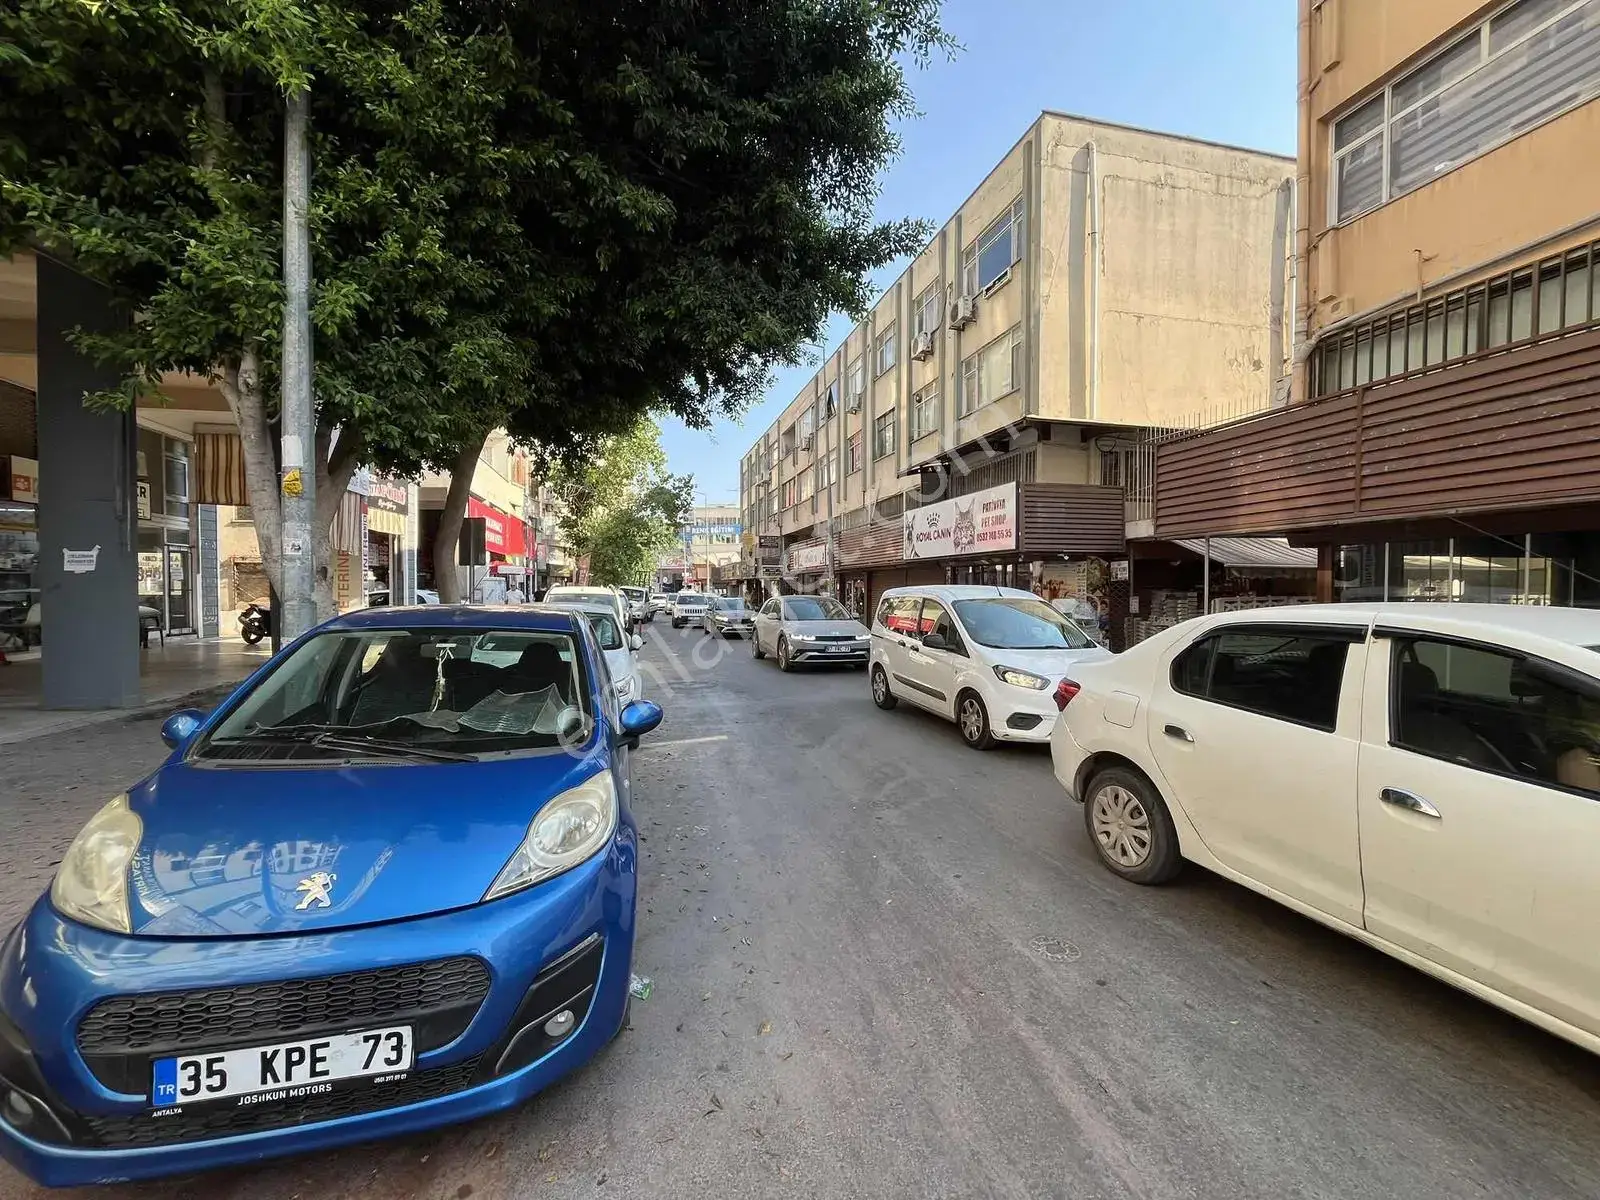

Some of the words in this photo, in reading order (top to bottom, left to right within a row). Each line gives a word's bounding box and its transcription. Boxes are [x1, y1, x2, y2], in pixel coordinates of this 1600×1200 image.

[916, 531, 933, 543] ROYAL
[933, 527, 952, 541] CANIN
[180, 1056, 228, 1097] 35
[260, 1041, 331, 1086] KPE
[362, 1031, 405, 1070] 73
[158, 1084, 175, 1096] TR
[237, 1089, 287, 1106] JOSHKUN
[289, 1083, 333, 1099] MOTORS
[151, 1107, 183, 1118] ANTALYA
